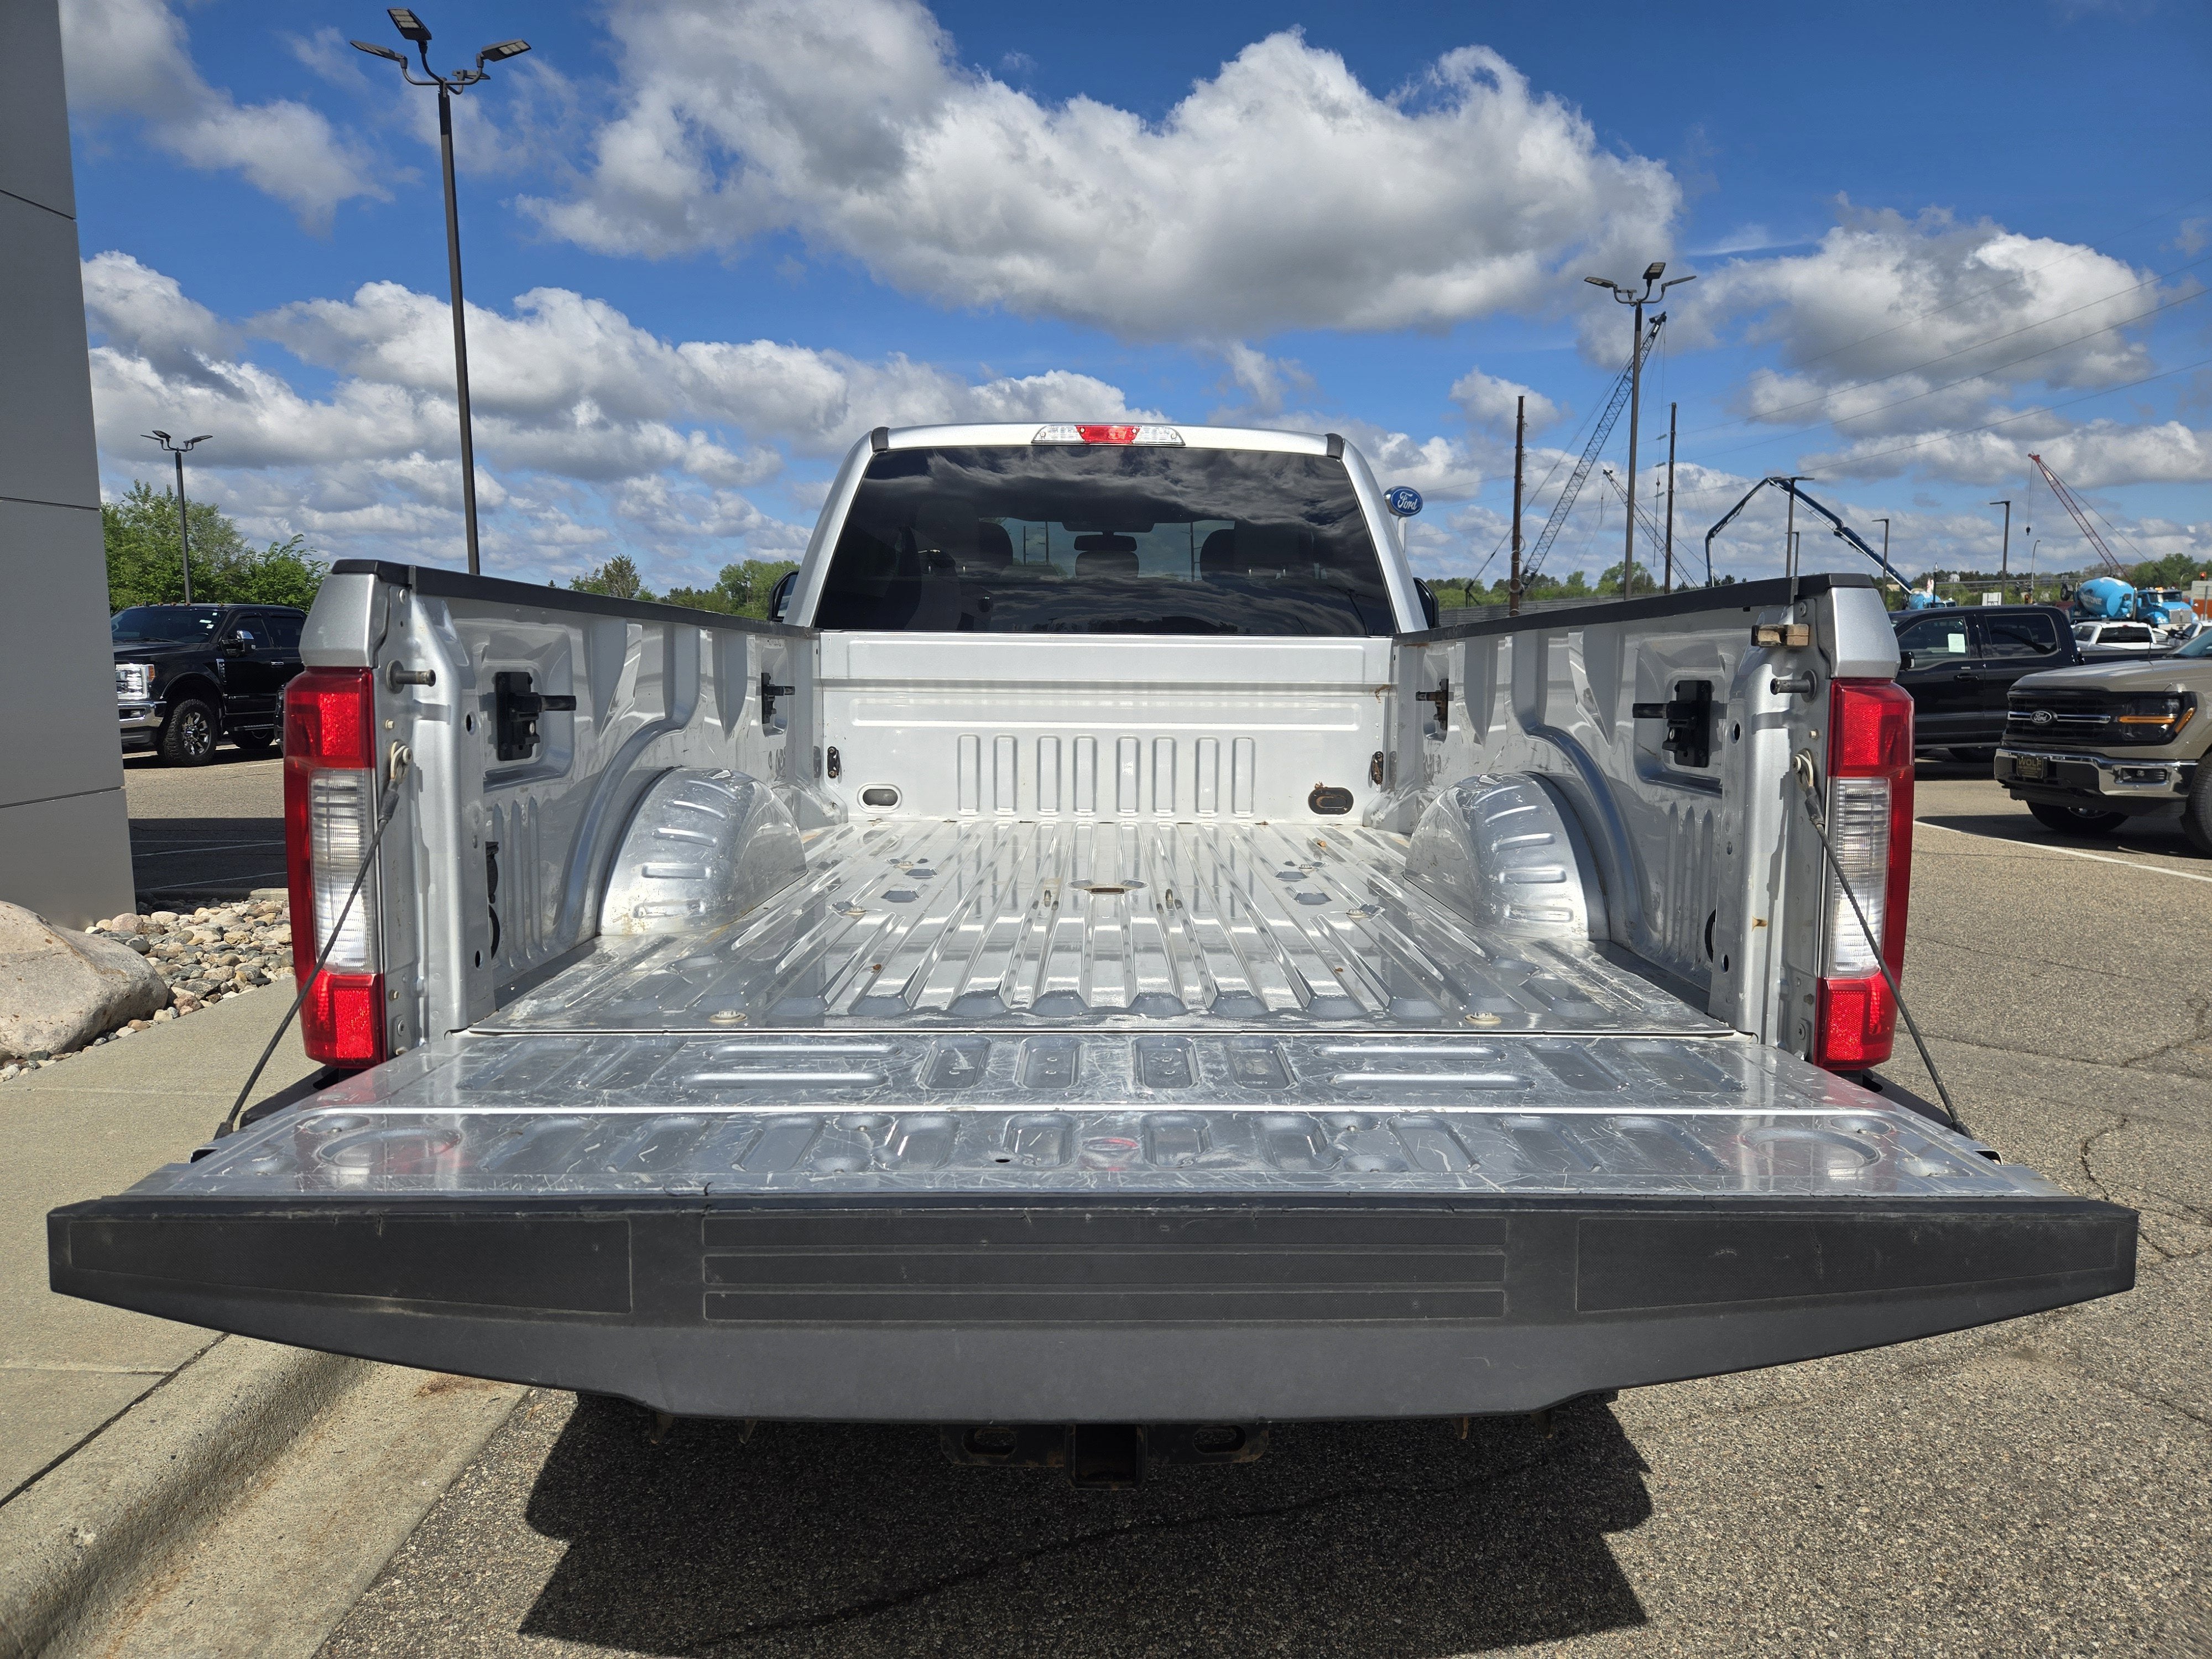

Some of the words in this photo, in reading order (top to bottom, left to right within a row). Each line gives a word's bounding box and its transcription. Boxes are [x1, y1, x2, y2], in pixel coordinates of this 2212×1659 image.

[1397, 491, 1417, 510] Ford
[2033, 712, 2047, 721] Ford
[2018, 757, 2042, 767] WOLF
